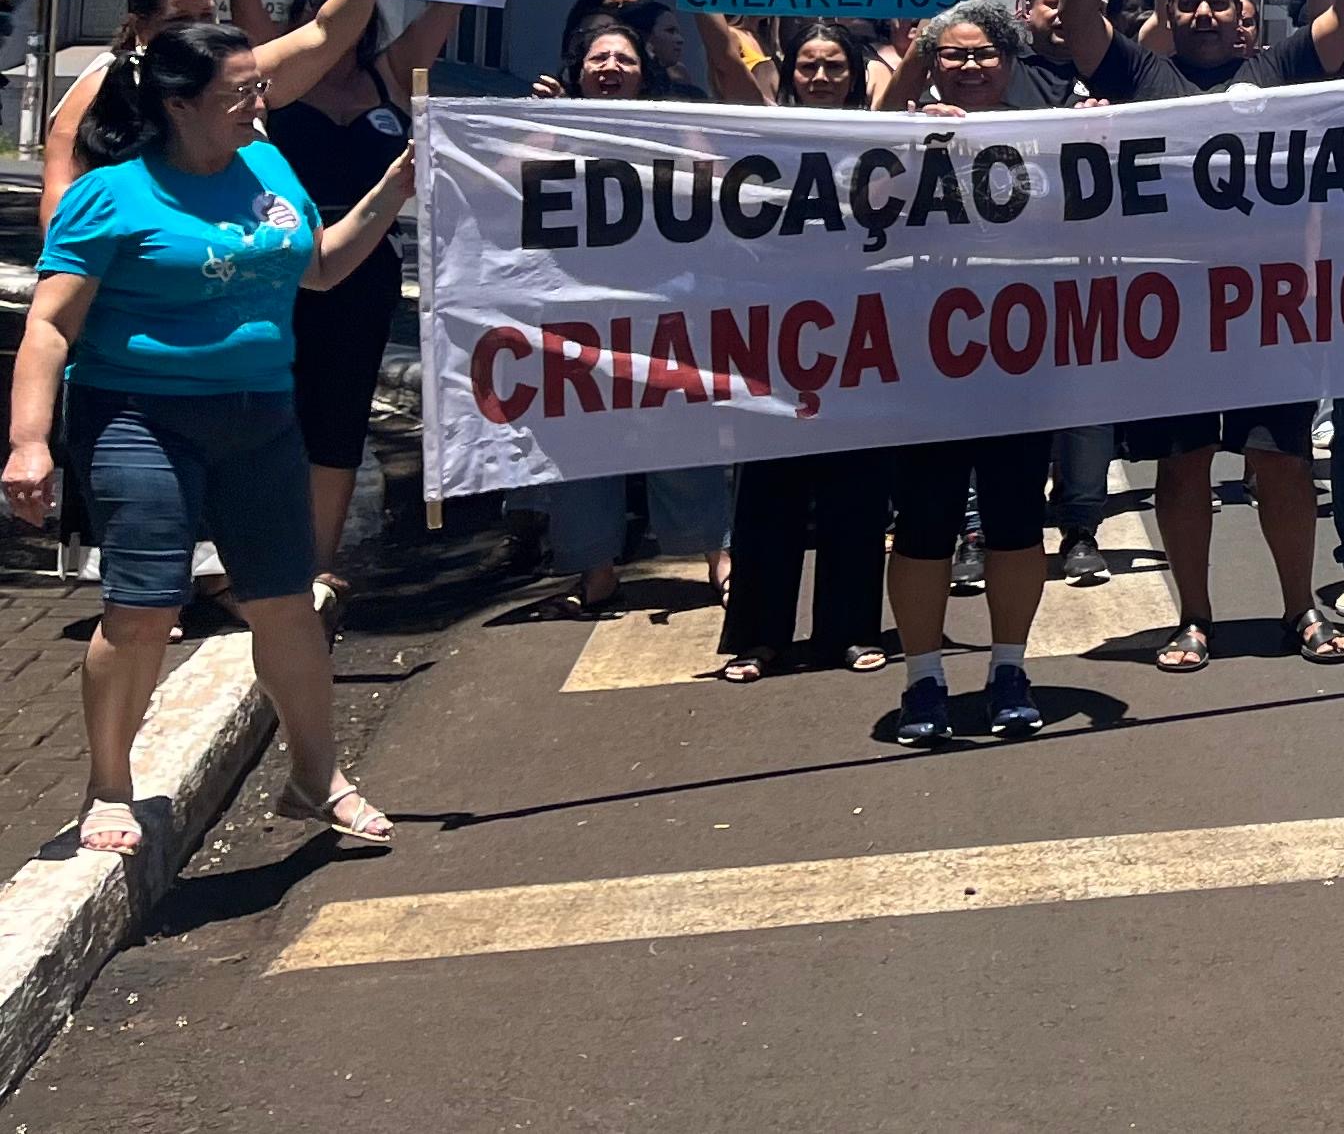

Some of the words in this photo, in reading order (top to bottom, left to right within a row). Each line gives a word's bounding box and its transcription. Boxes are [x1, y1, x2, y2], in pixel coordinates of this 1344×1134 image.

[519, 131, 1033, 253] EDUCAÇÃO
[1060, 137, 1169, 222] DE
[470, 291, 900, 421] CRIANÇA
[928, 271, 1181, 379] COMO
